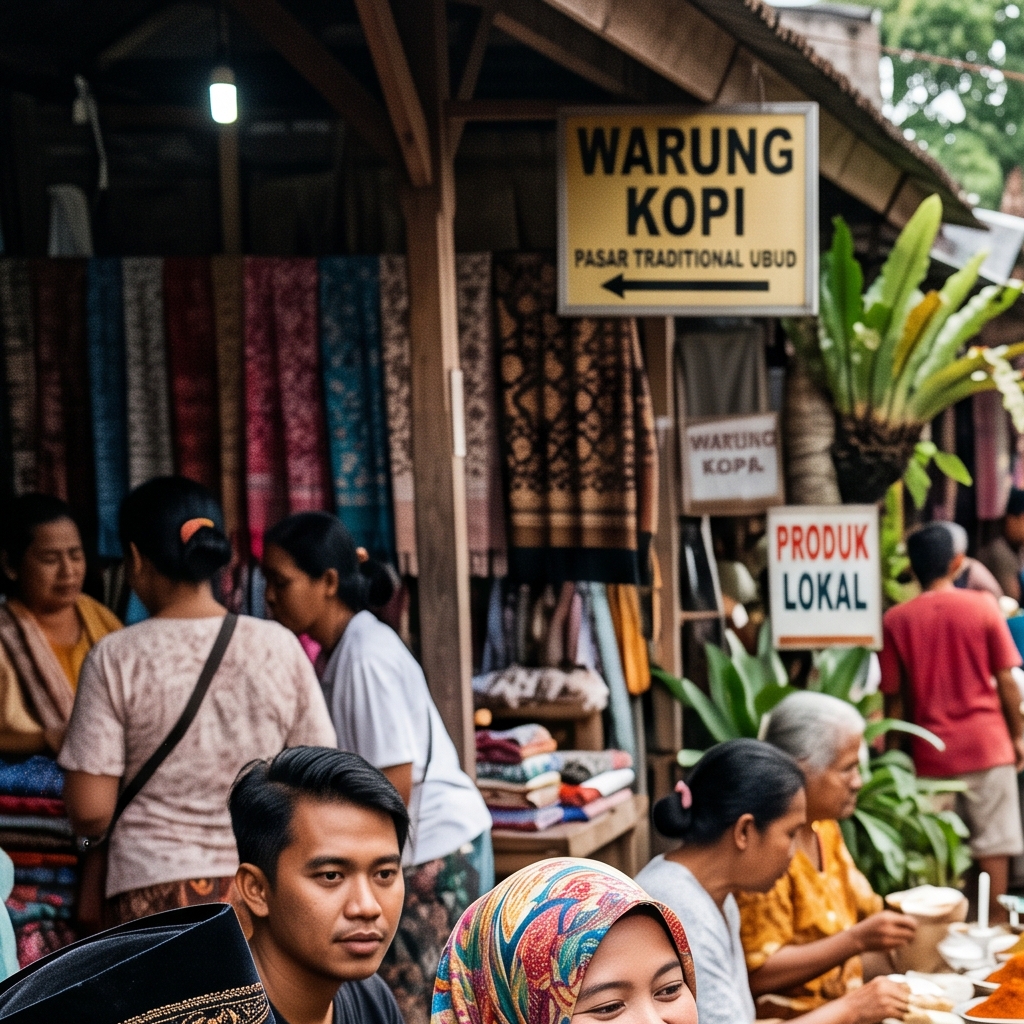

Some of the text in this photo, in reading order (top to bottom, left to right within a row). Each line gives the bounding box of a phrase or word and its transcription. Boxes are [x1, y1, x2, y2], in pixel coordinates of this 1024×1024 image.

[576, 126, 794, 176] WARUNG
[626, 186, 745, 237] KOPI
[574, 248, 798, 269] PASAR TRADITIONAL UBUD
[776, 523, 869, 562] PRODUK
[783, 571, 867, 611] LOKAL
